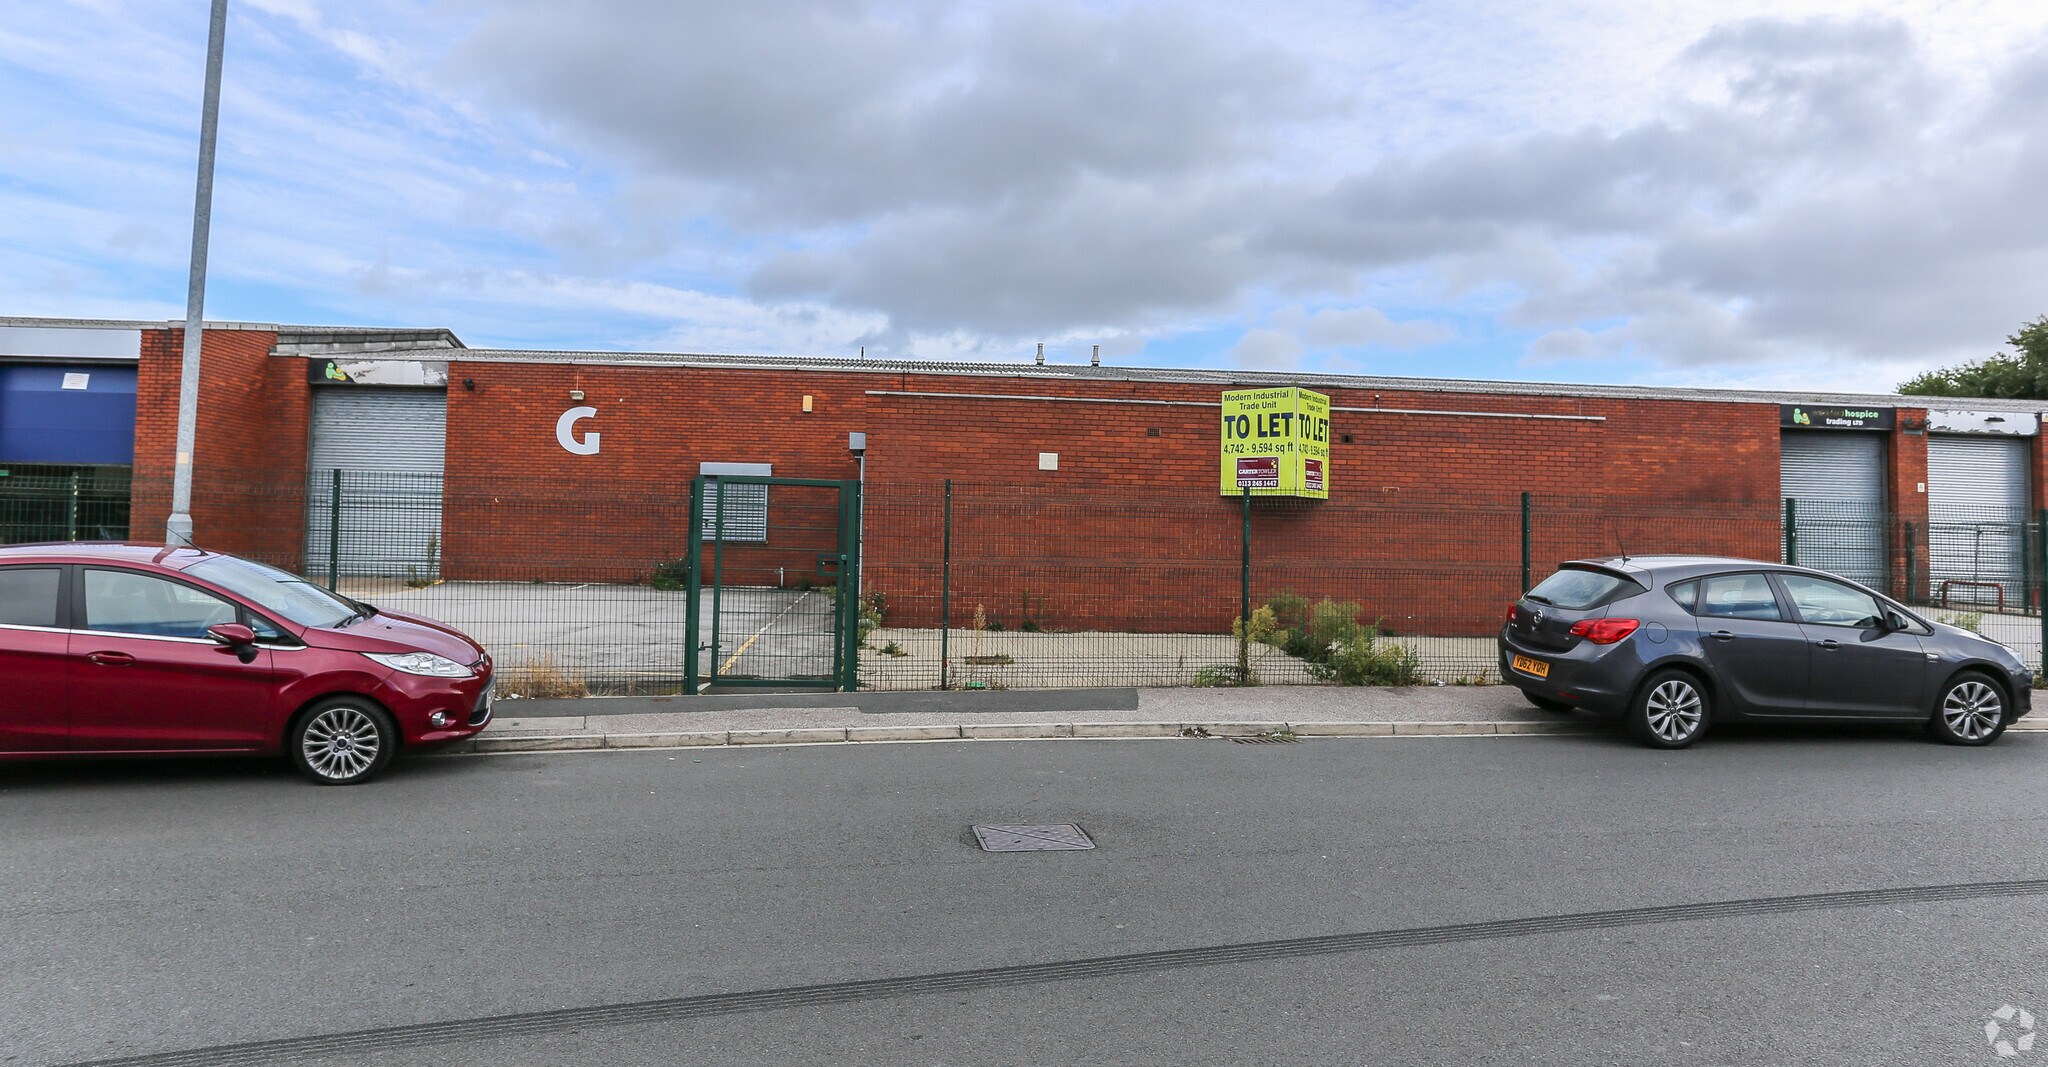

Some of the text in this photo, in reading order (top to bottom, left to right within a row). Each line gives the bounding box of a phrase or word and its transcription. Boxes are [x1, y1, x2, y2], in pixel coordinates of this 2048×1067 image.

[1224, 394, 1252, 402] Modern
[1253, 390, 1289, 400] Industrial
[1239, 400, 1277, 410] Trade Unit
[1844, 409, 1879, 419] hospice
[1224, 412, 1294, 439] TO LET
[1298, 413, 1329, 443] TO LET
[1826, 417, 1852, 426] trading
[556, 406, 600, 454] G
[1223, 443, 1245, 456] 4,742
[1251, 442, 1273, 454] 9,594
[1275, 444, 1285, 455] sq
[1287, 441, 1294, 452] ft
